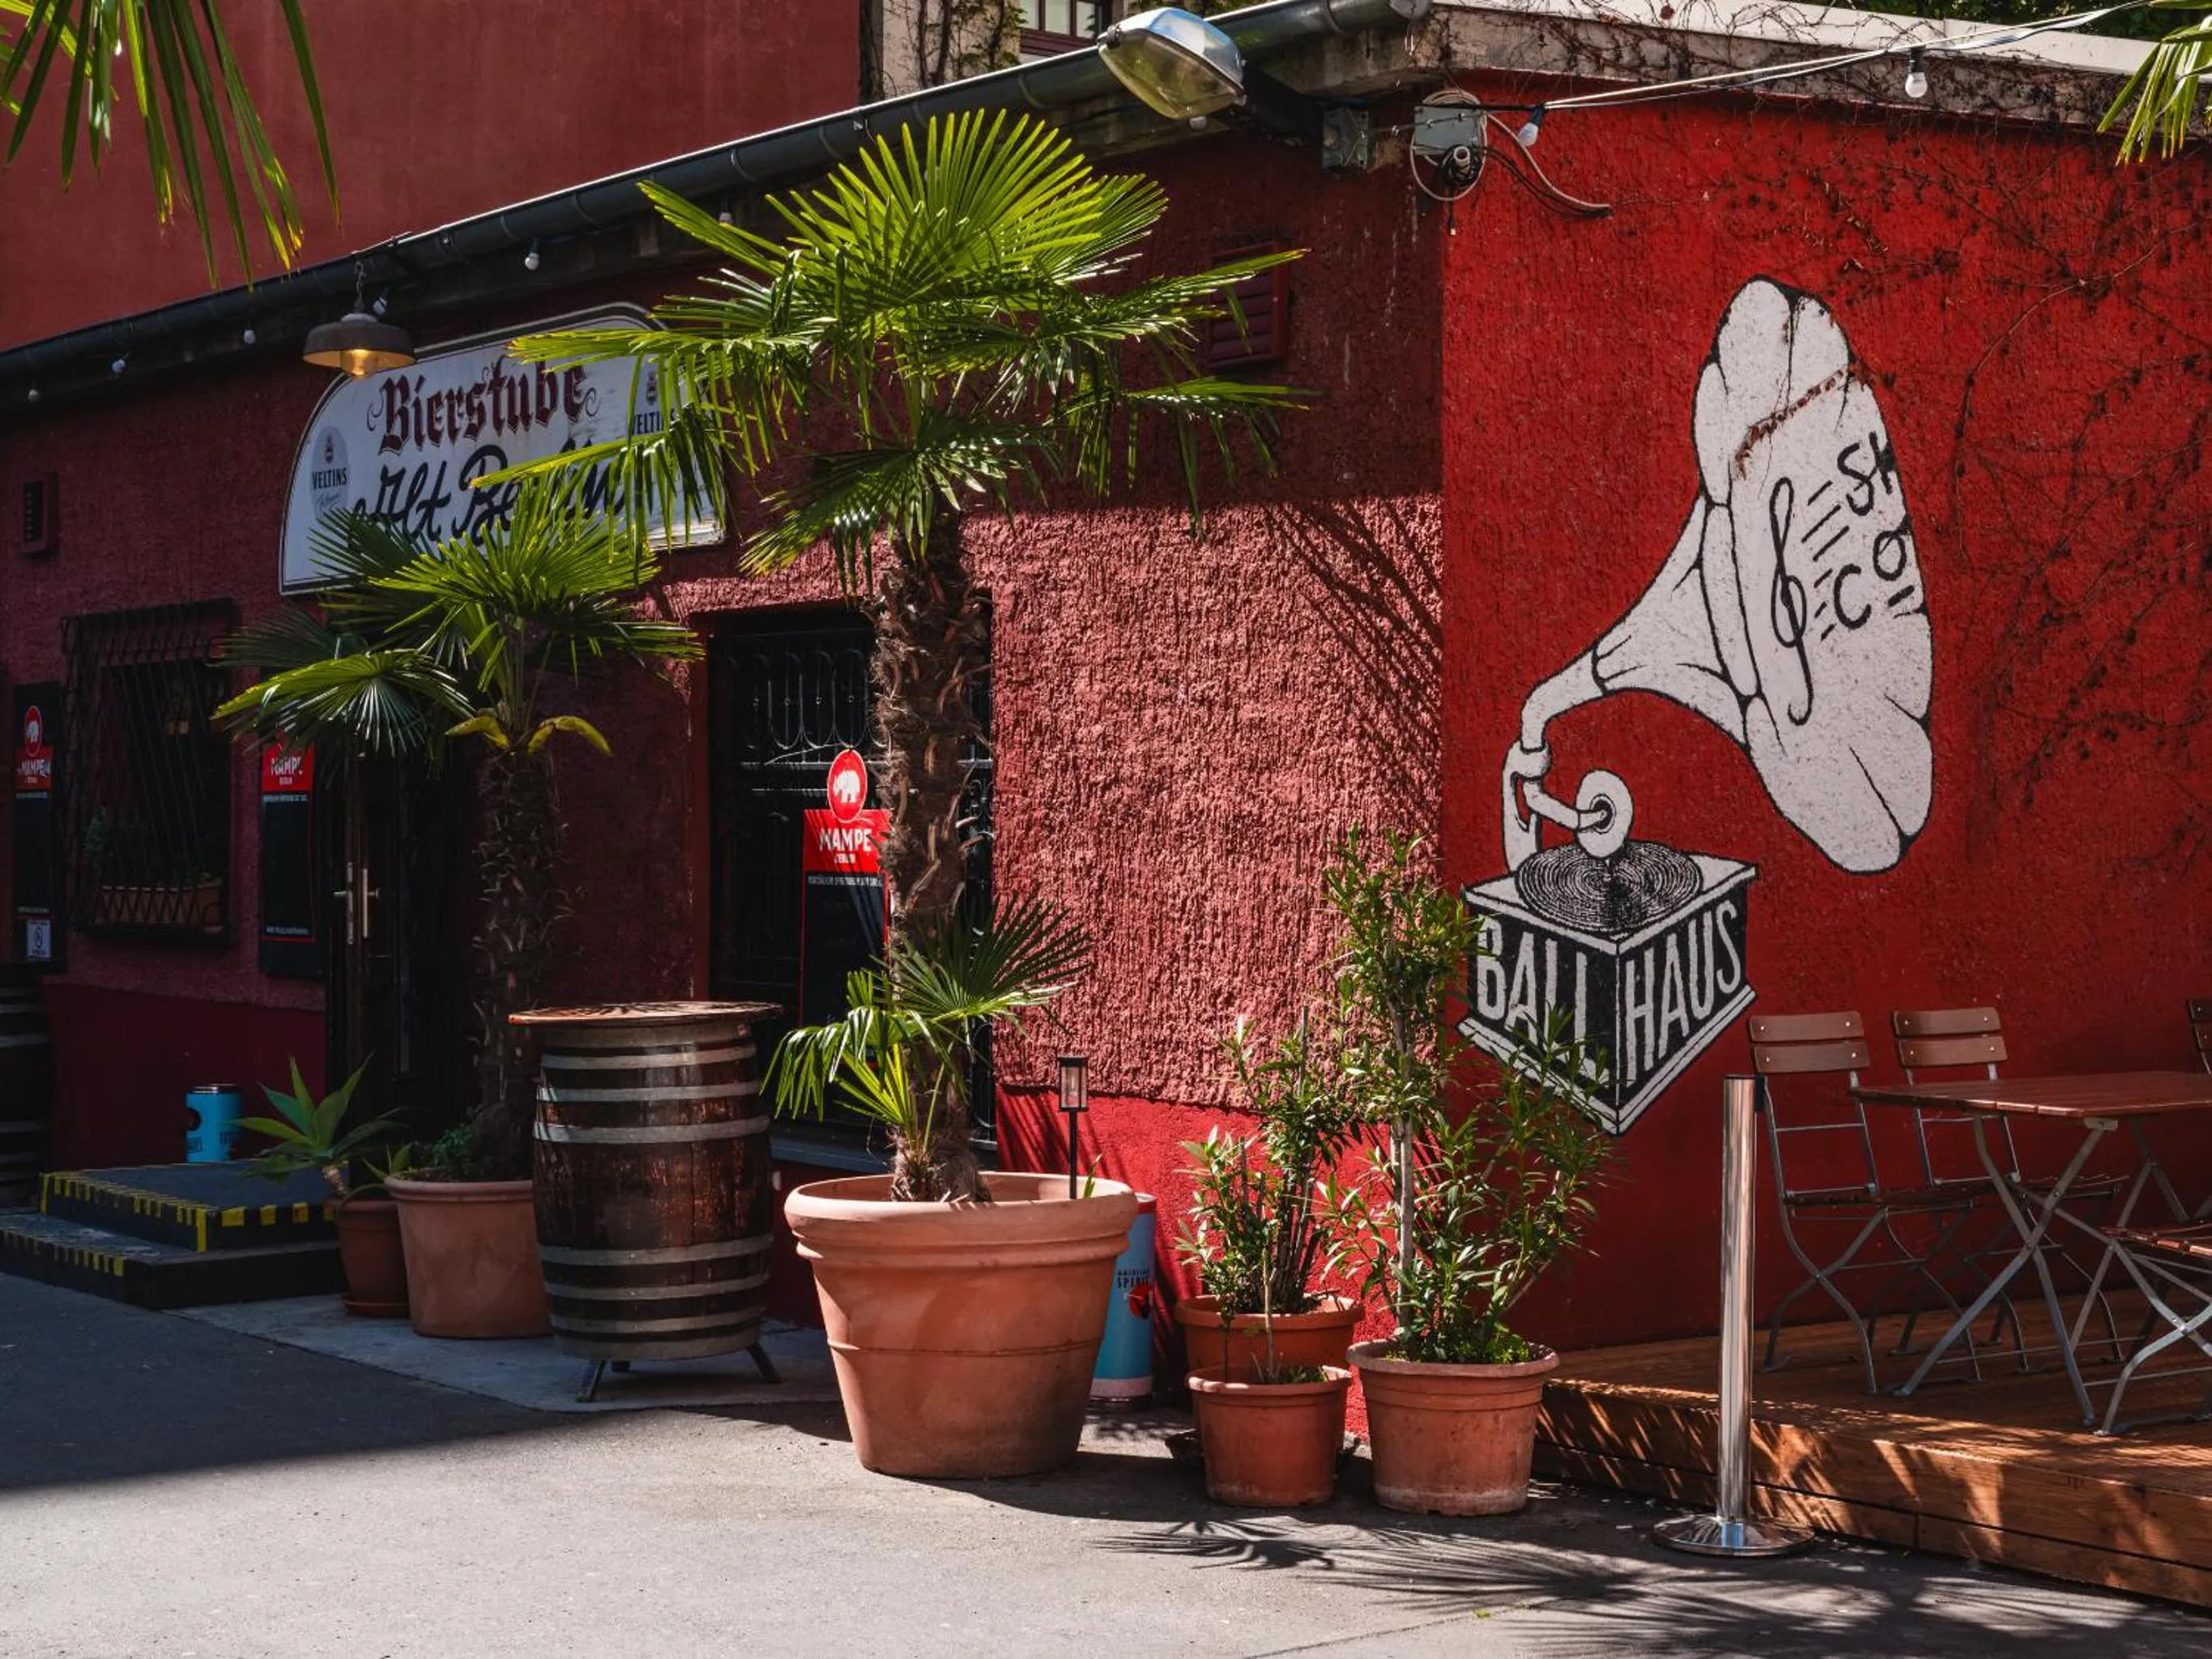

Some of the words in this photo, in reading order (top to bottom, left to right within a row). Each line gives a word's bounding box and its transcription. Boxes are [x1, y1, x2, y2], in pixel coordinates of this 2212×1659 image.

[367, 354, 599, 456] Bierstube
[312, 467, 347, 489] VELTINS
[820, 828, 872, 852] MAMPE
[1625, 899, 1741, 1088] HAUS
